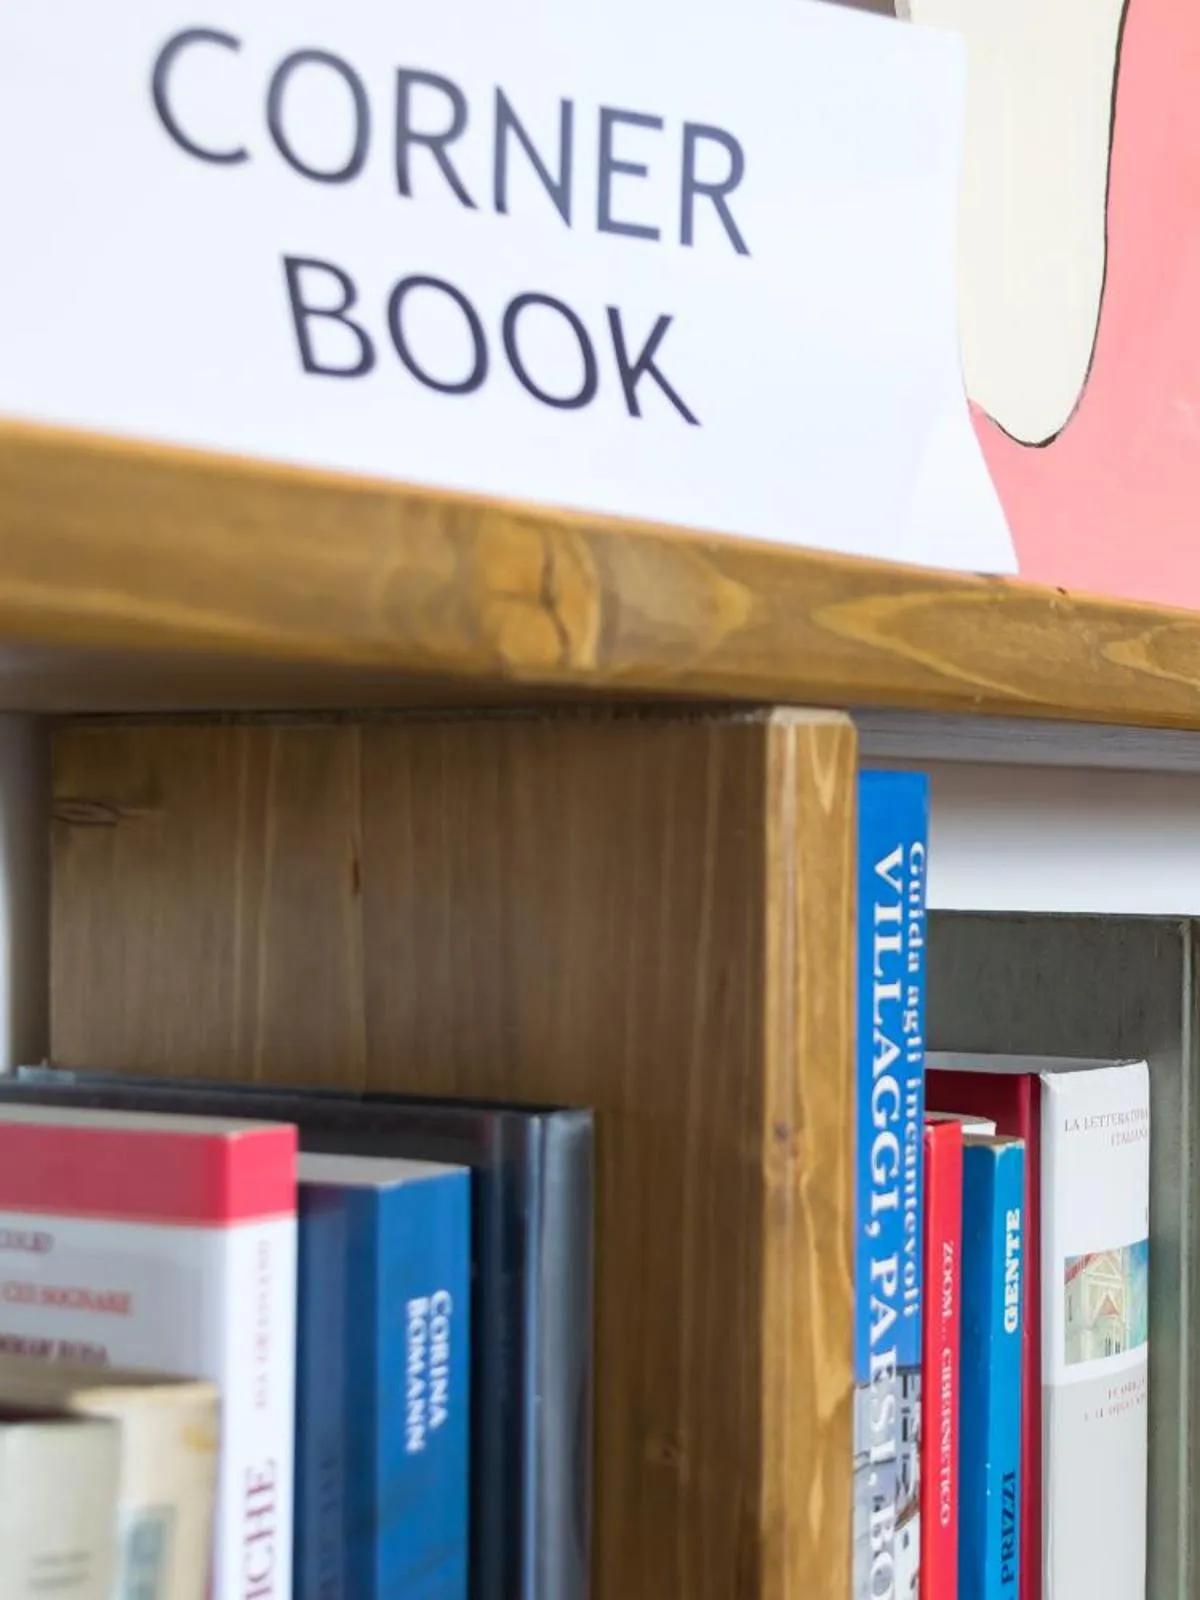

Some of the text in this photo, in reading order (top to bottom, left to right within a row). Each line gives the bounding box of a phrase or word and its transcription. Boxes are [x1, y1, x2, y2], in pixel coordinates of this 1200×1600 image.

[150, 25, 752, 257] CORNER
[281, 253, 702, 427] BOOK
[864, 841, 904, 1237] VILLAGGI,
[903, 841, 925, 1316] Guida agli incantevoli
[428, 1289, 453, 1430] CORINA
[1004, 1207, 1020, 1334] GENTE
[868, 1252, 899, 1487] PAESI,
[938, 1346, 952, 1528] CIBERNETICO
[1002, 1470, 1015, 1584] PRIZZI
